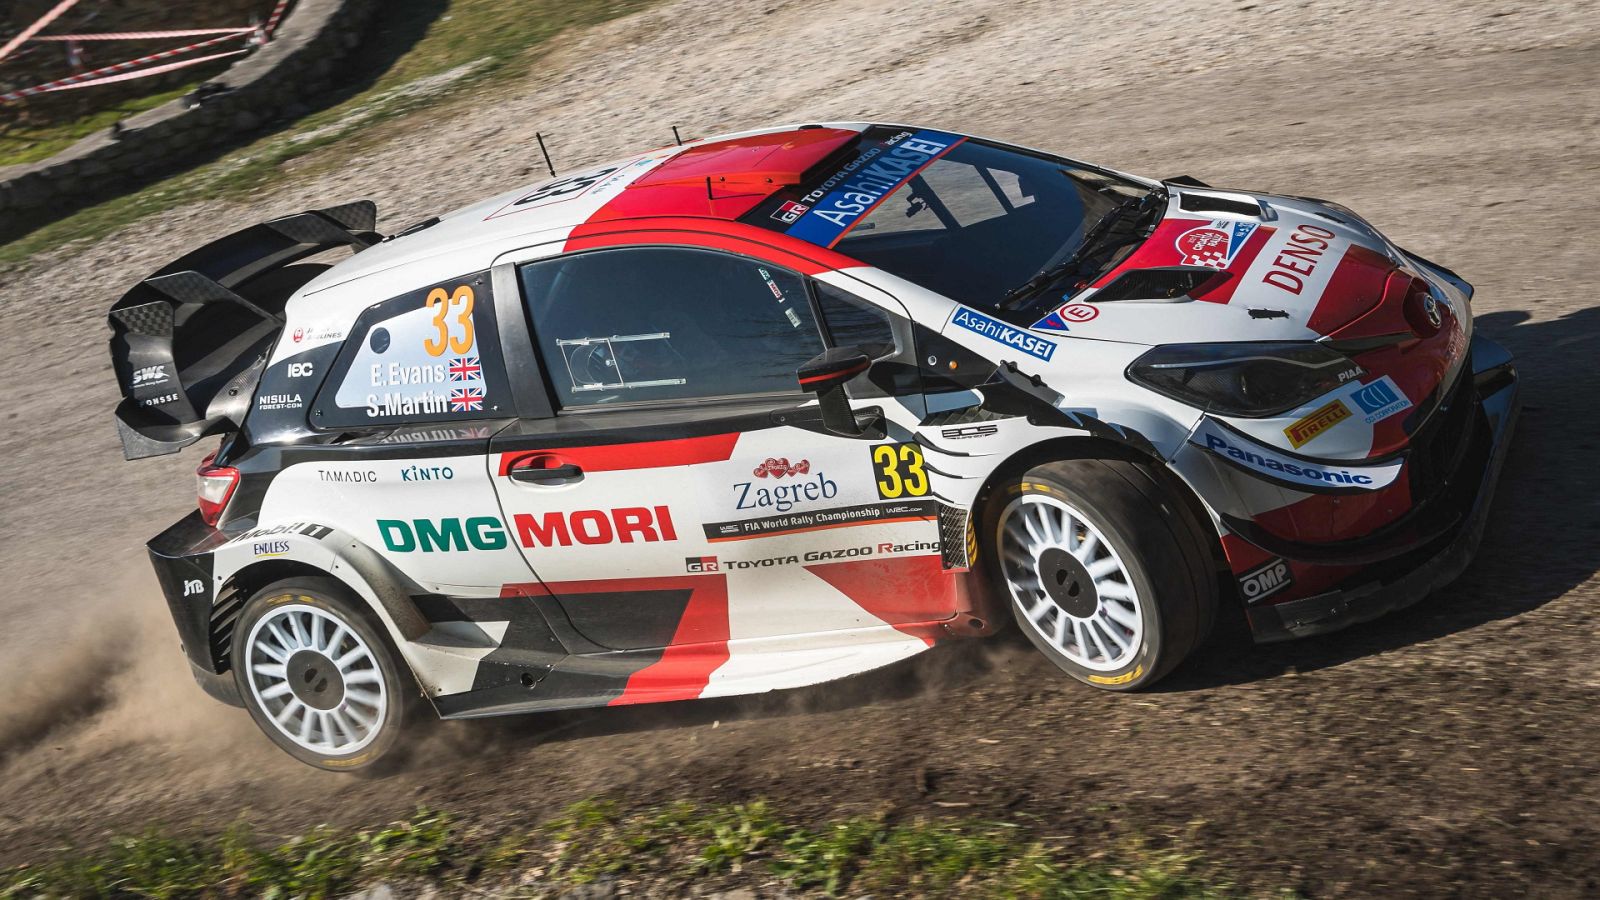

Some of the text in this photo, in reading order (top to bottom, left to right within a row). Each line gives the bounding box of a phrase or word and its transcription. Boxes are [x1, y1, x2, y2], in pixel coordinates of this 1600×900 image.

[780, 203, 810, 223] GR
[801, 167, 847, 204] TOYOTA
[812, 137, 948, 228] AsahiKASEI
[1262, 224, 1336, 296] DENSO
[424, 285, 475, 357] 33
[955, 311, 1052, 358] AsahiKASEI
[371, 362, 446, 387] E.Evans
[1338, 366, 1363, 383] PIAA
[259, 393, 302, 404] NISULA
[366, 390, 448, 418] S.Martin
[1288, 402, 1347, 443] PIRELLI
[318, 471, 377, 482] TAMADIC
[874, 445, 928, 498] 33
[1206, 433, 1373, 485] Panasonic
[733, 472, 837, 512] Zagreb
[376, 516, 507, 553] DMG
[513, 505, 678, 549] MORI
[744, 523, 760, 532] FIA
[761, 518, 789, 530] World
[790, 515, 814, 527] Rally
[815, 507, 881, 524] Championship
[254, 541, 289, 555] ENDLESS
[686, 541, 941, 573] GR TOYOTA GAZOO Racing
[183, 579, 205, 597] JTB
[1243, 563, 1288, 598] OMP
